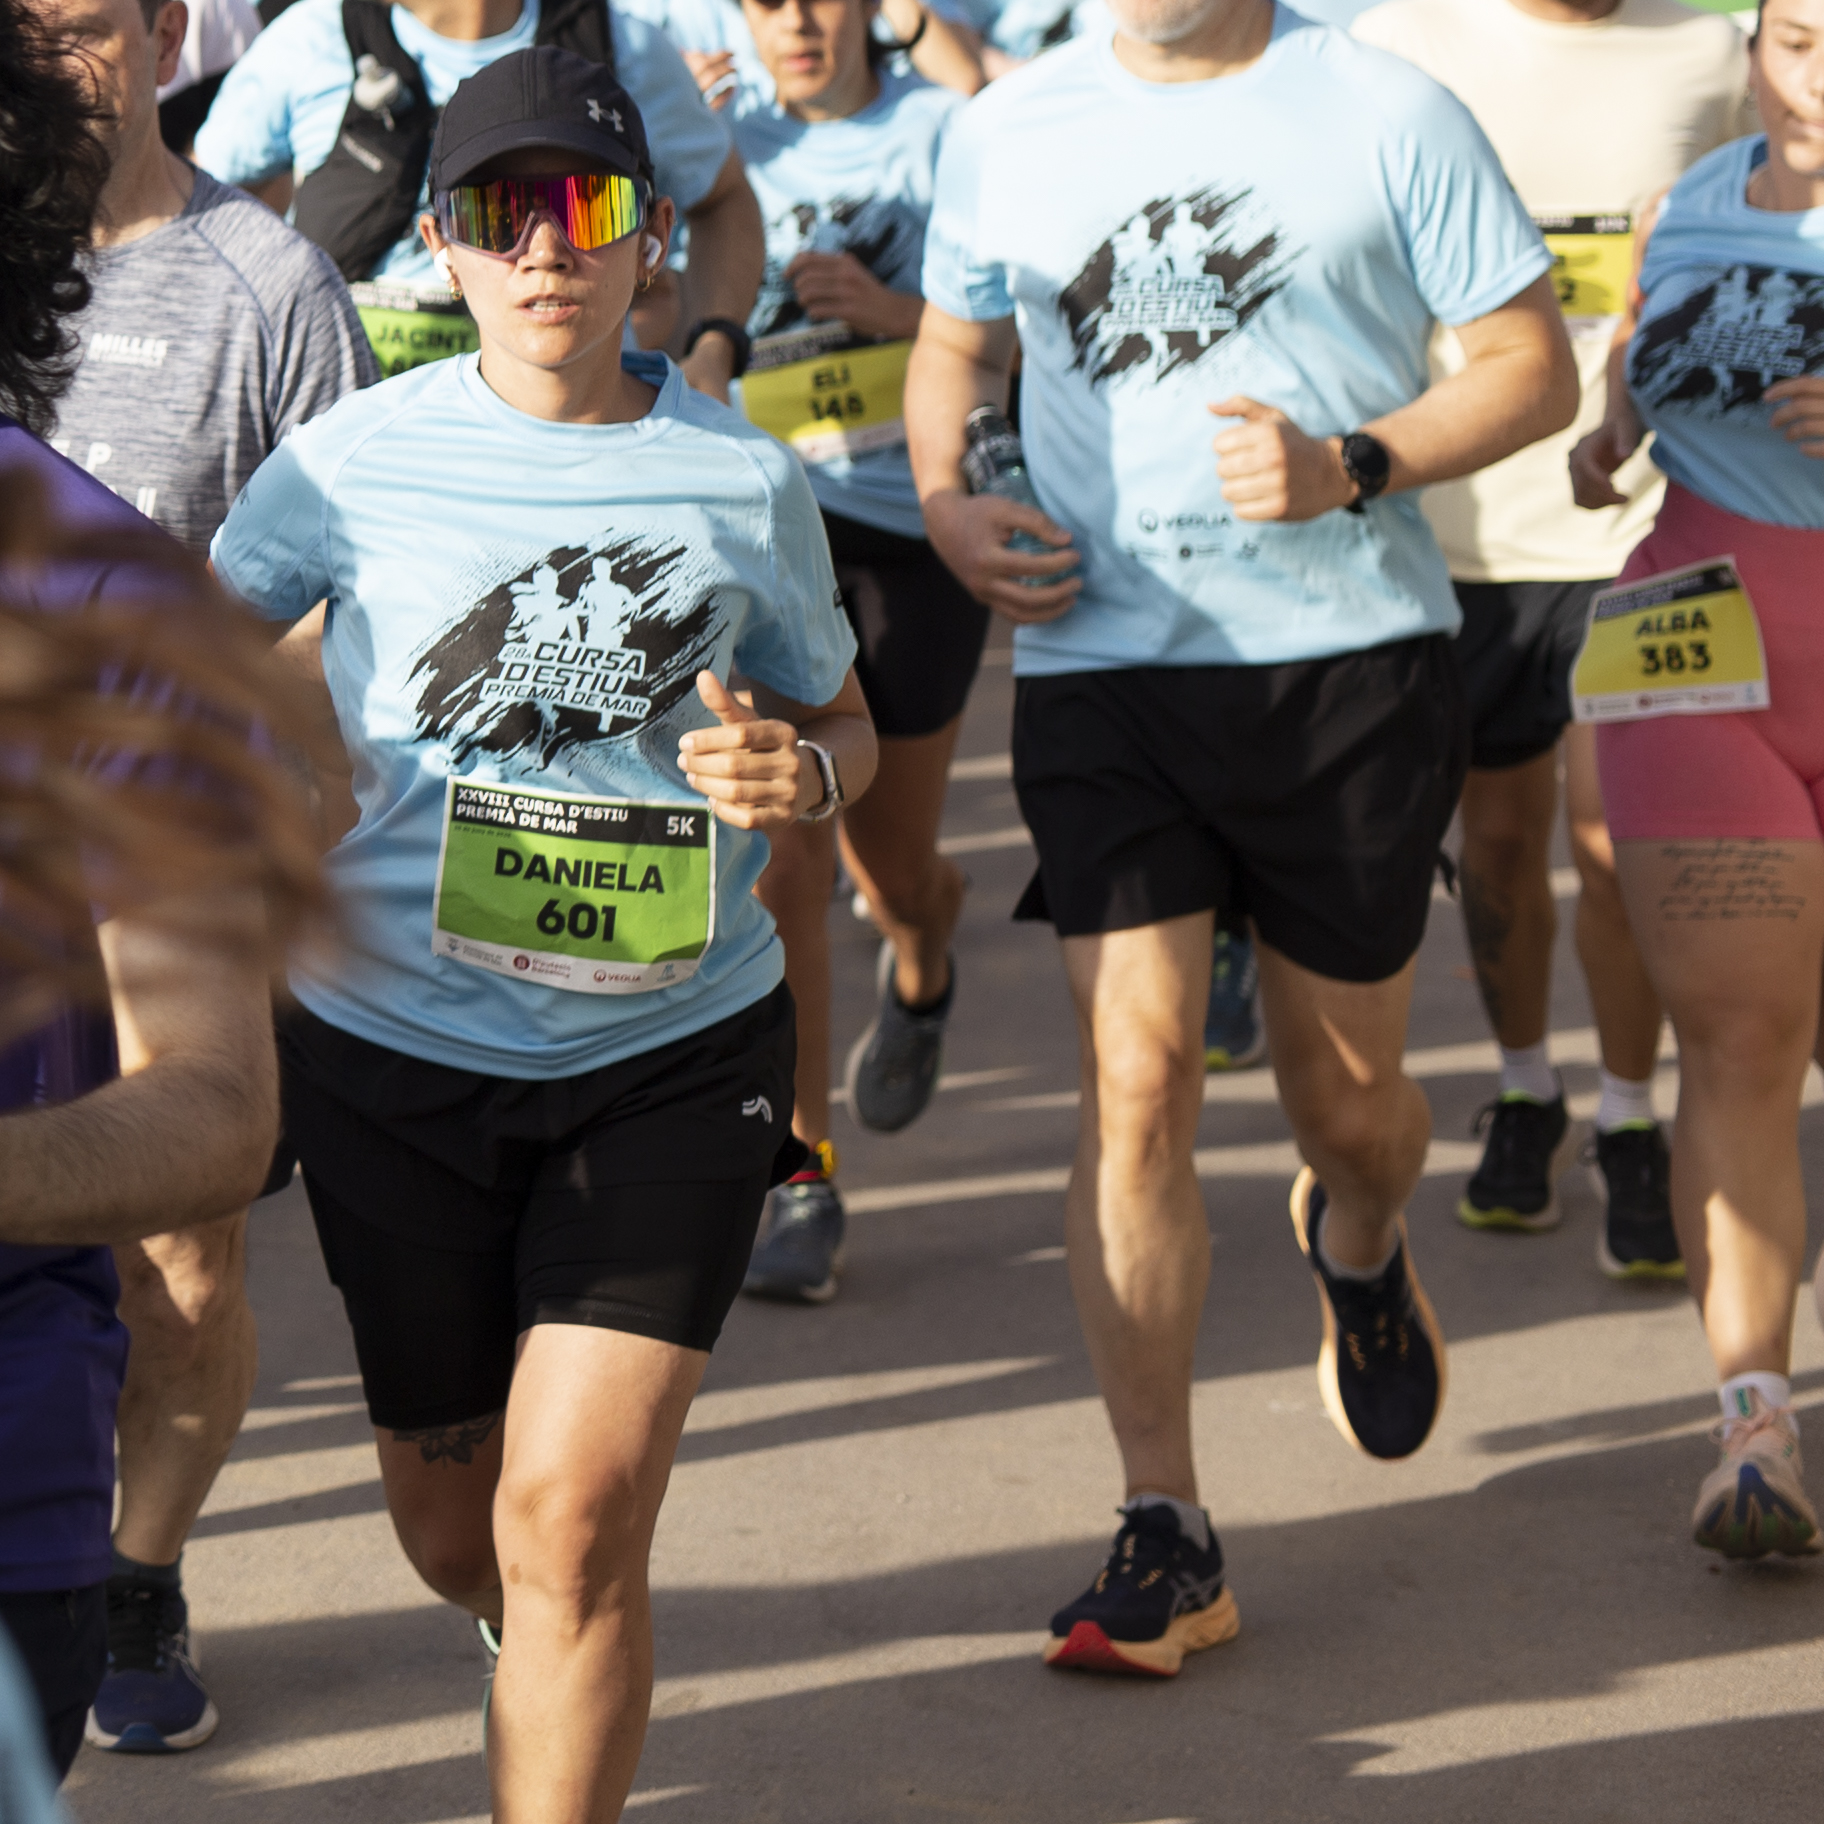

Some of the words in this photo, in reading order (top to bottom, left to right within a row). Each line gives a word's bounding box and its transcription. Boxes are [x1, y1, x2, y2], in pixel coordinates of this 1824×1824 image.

[379, 324, 470, 349] JACINT
[1636, 607, 1711, 639] ALBA
[533, 642, 642, 675] CURSA
[1640, 639, 1712, 676] 383
[504, 663, 627, 694] D'ESTIU
[570, 691, 600, 706] DE
[601, 697, 647, 714] MAR
[456, 803, 516, 824] PREMIÀ
[519, 814, 540, 829] DE
[543, 816, 578, 834] MAR
[457, 787, 510, 808] XXVIII
[513, 797, 564, 817] CURSA
[569, 804, 629, 822] D'ESTIU
[667, 815, 696, 837] 5K
[494, 846, 665, 894] DANIELA
[536, 899, 617, 942] 601
[607, 974, 642, 984] VEOLIA
